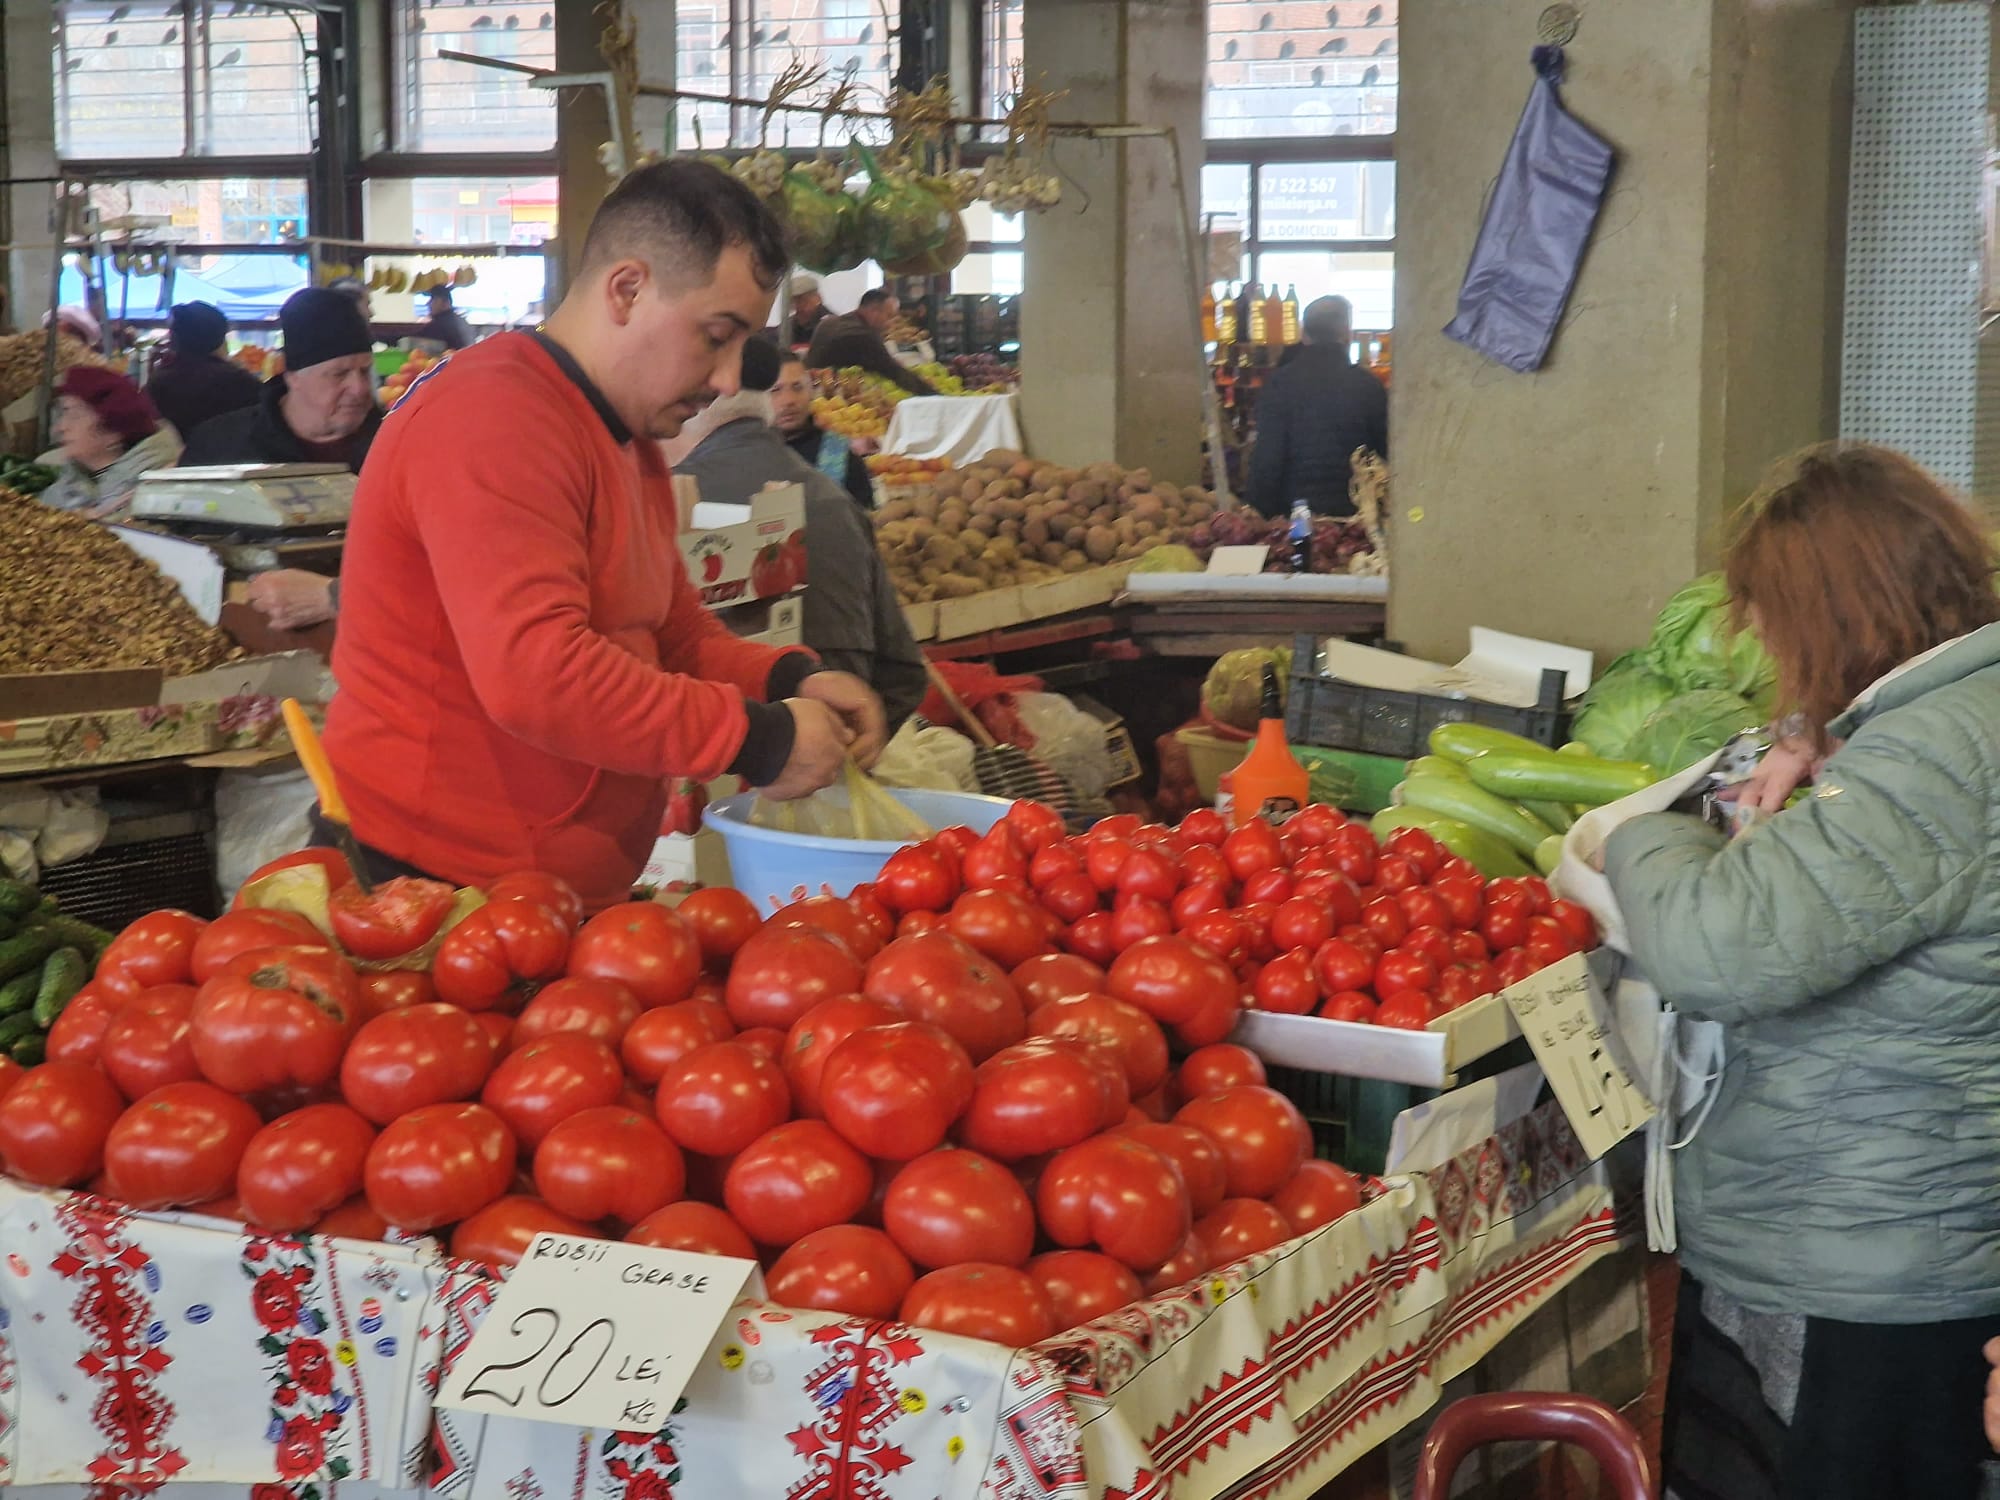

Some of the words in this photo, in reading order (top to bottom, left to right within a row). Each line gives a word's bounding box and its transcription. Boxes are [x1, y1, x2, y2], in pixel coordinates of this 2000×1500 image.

[1280, 177, 1307, 193] 522
[1309, 177, 1337, 193] 567
[1279, 224, 1338, 237] DOMICILIU
[621, 1263, 710, 1294] GRASE
[460, 1307, 616, 1407] 20
[618, 1400, 657, 1424] KG
